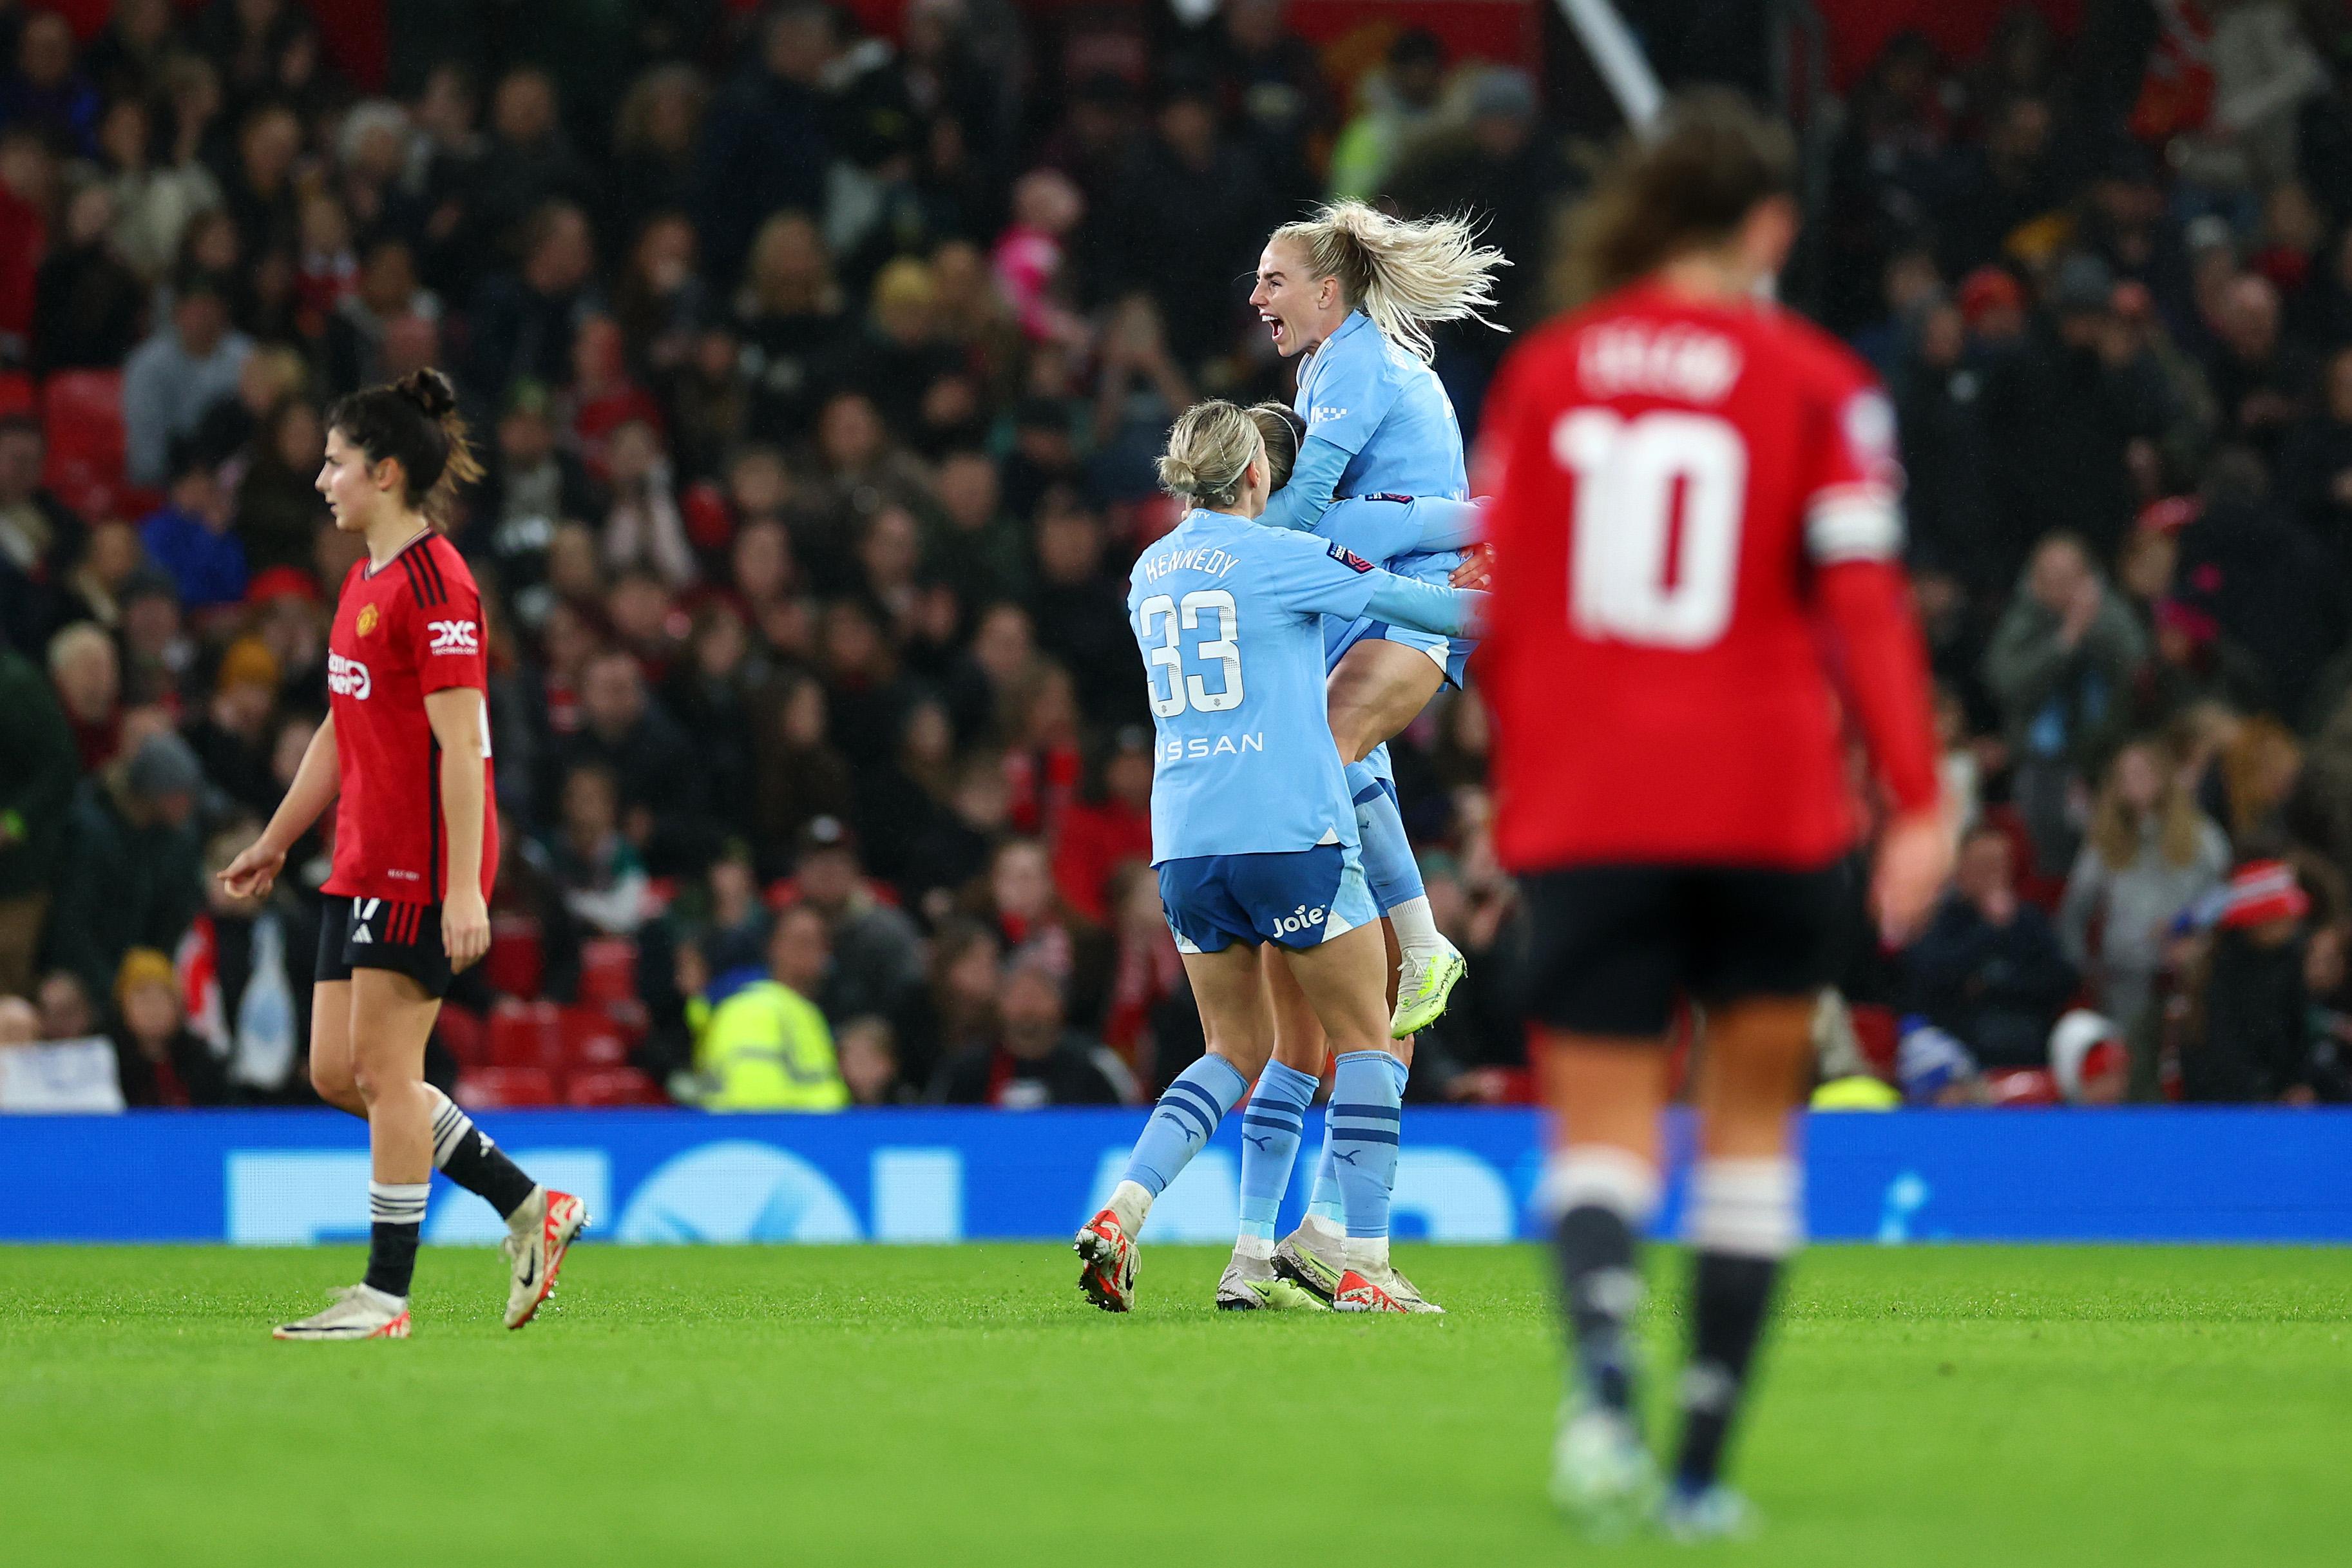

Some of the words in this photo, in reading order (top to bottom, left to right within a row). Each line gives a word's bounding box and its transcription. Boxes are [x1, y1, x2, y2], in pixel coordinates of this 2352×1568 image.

[1551, 407, 1748, 649] 10
[1145, 548, 1241, 584] KENNEDY
[427, 620, 478, 648] DXC
[1139, 589, 1245, 718] 33
[1154, 732, 1263, 763] NISSAN
[1273, 904, 1324, 939] Joie
